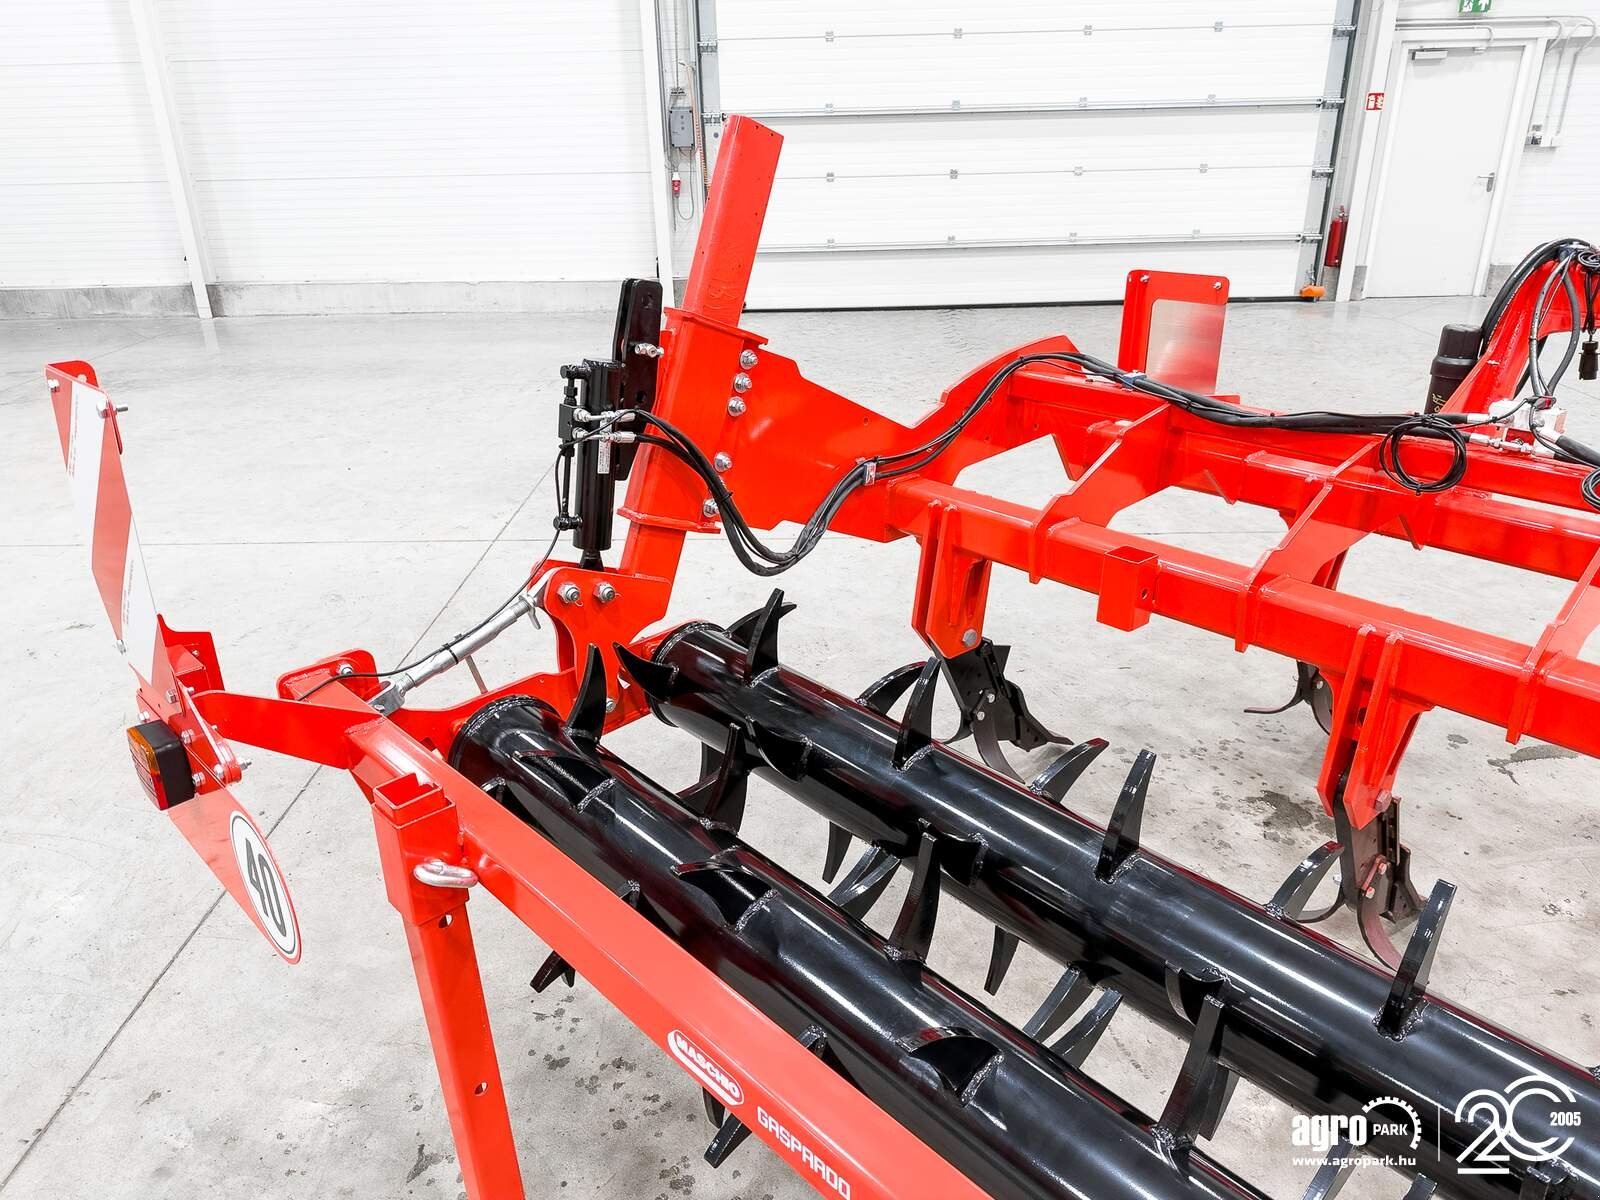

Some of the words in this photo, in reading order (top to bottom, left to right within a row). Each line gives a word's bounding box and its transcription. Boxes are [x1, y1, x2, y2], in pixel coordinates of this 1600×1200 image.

[245, 838, 287, 937] 40
[675, 1034, 740, 1099] MASCHIO
[757, 1107, 851, 1200] GASPARDO
